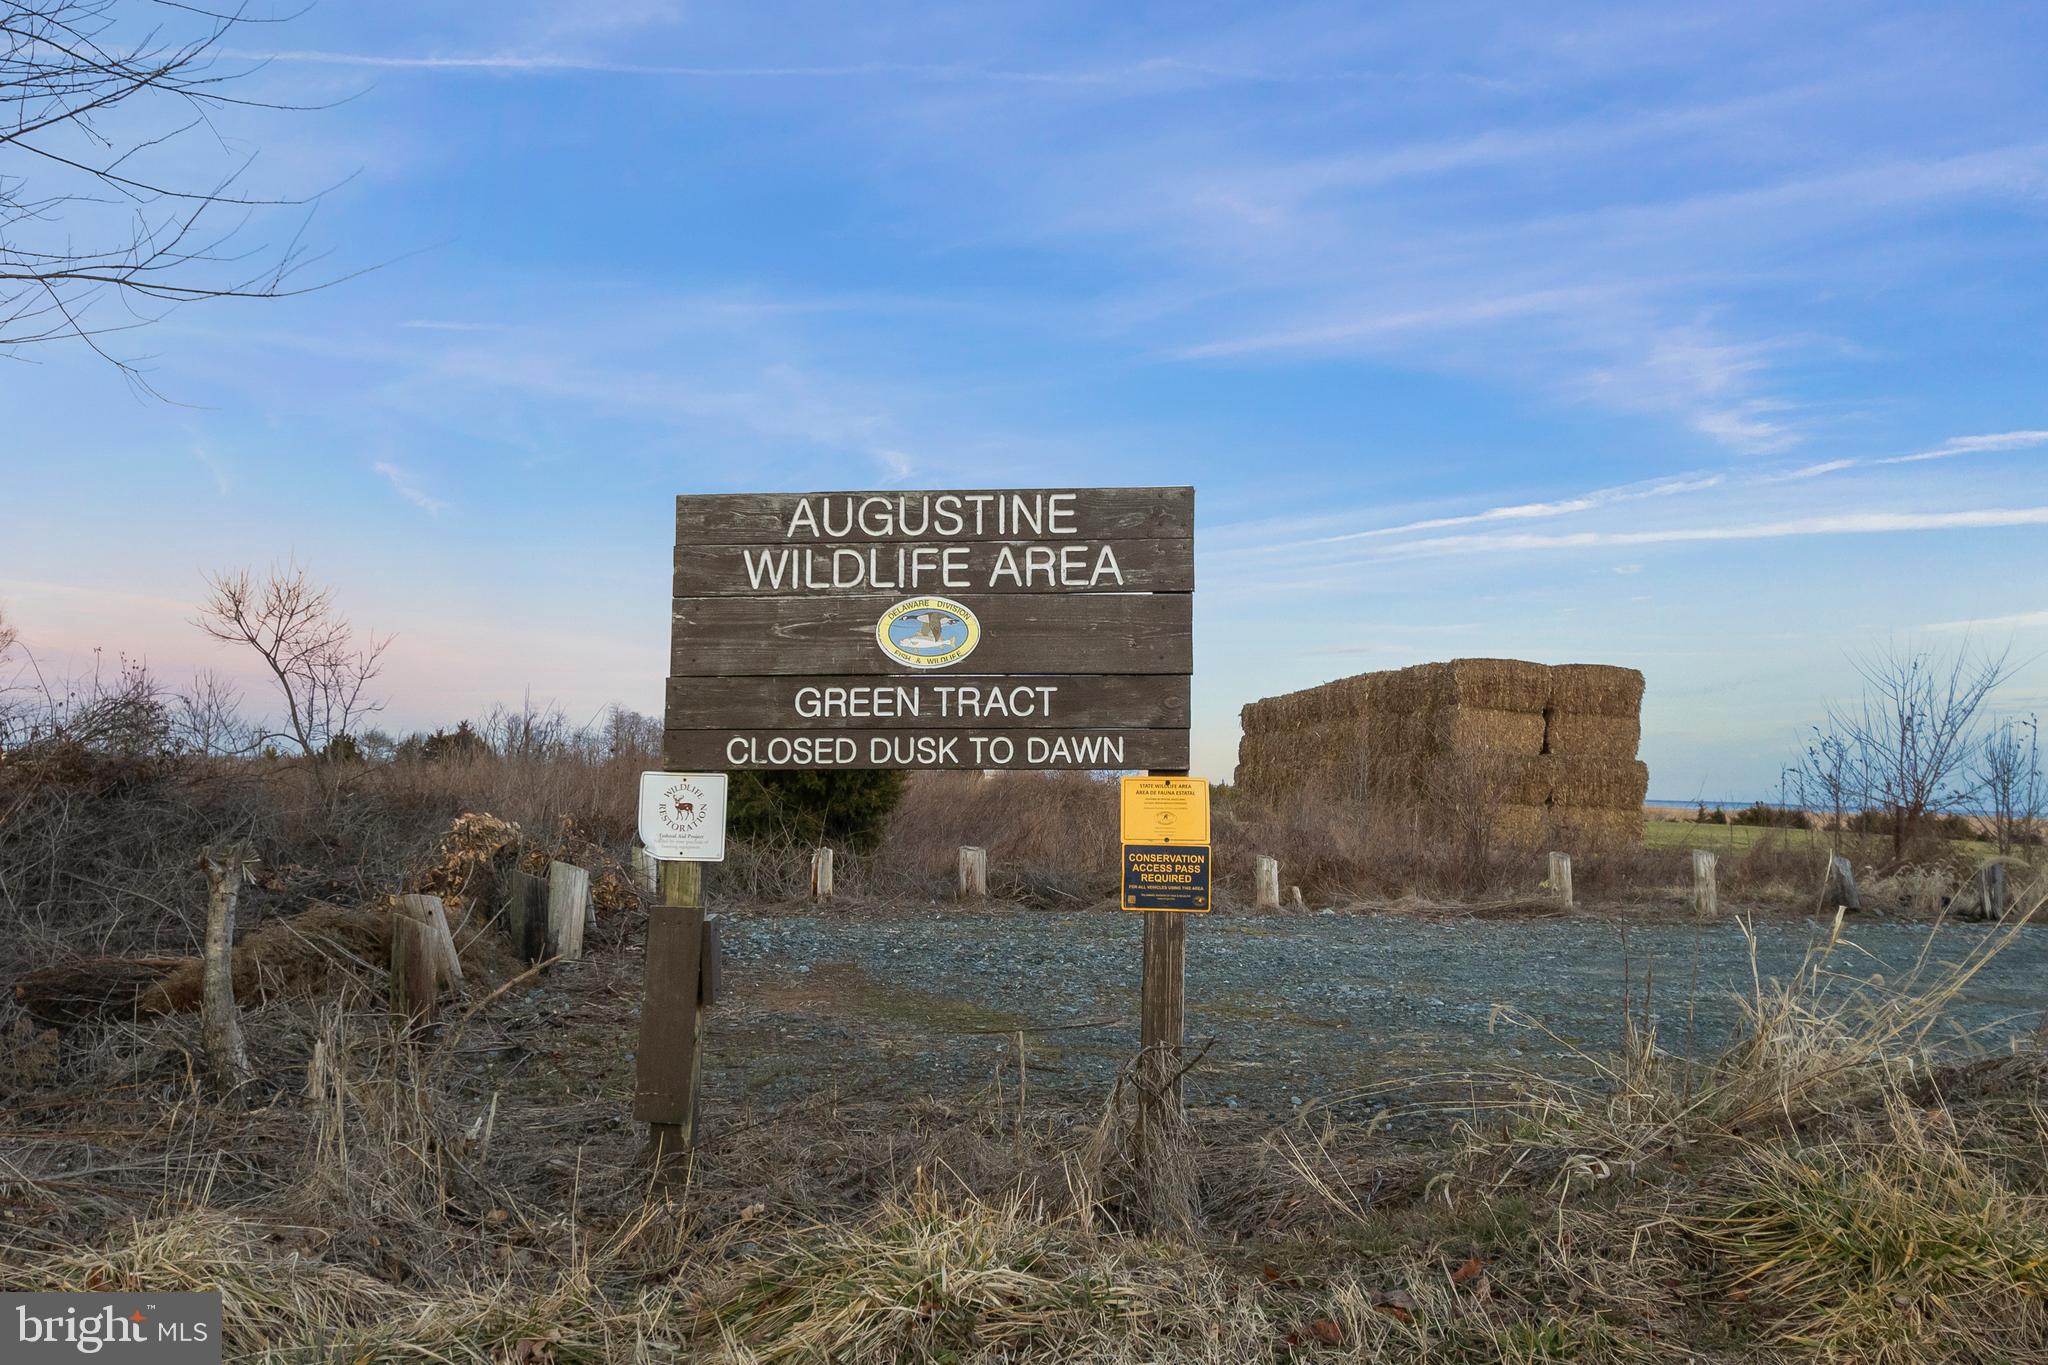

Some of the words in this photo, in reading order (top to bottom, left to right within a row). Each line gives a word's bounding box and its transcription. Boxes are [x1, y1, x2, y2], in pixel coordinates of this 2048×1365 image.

[786, 493, 1078, 539] AUGUSTINE
[743, 546, 972, 590] WILDLIFE
[988, 544, 1125, 587] AREA
[887, 600, 930, 620] DELAWARE
[937, 600, 972, 620] DIVISION
[927, 650, 962, 664] WILDLIFE
[794, 686, 920, 717] GREEN
[933, 685, 1058, 717] TRACT
[726, 736, 858, 765] CLOSED
[869, 737, 959, 765] DUSK
[968, 737, 1015, 764] TO
[1026, 736, 1125, 764] DAWN
[664, 784, 704, 799] WILDLIFE
[659, 803, 708, 832] RESTORATION
[1128, 853, 1205, 864] CONSERVATION
[1132, 863, 1173, 873] ACCESS
[1175, 864, 1201, 874] PASS
[1141, 873, 1192, 883] REQUIRED
